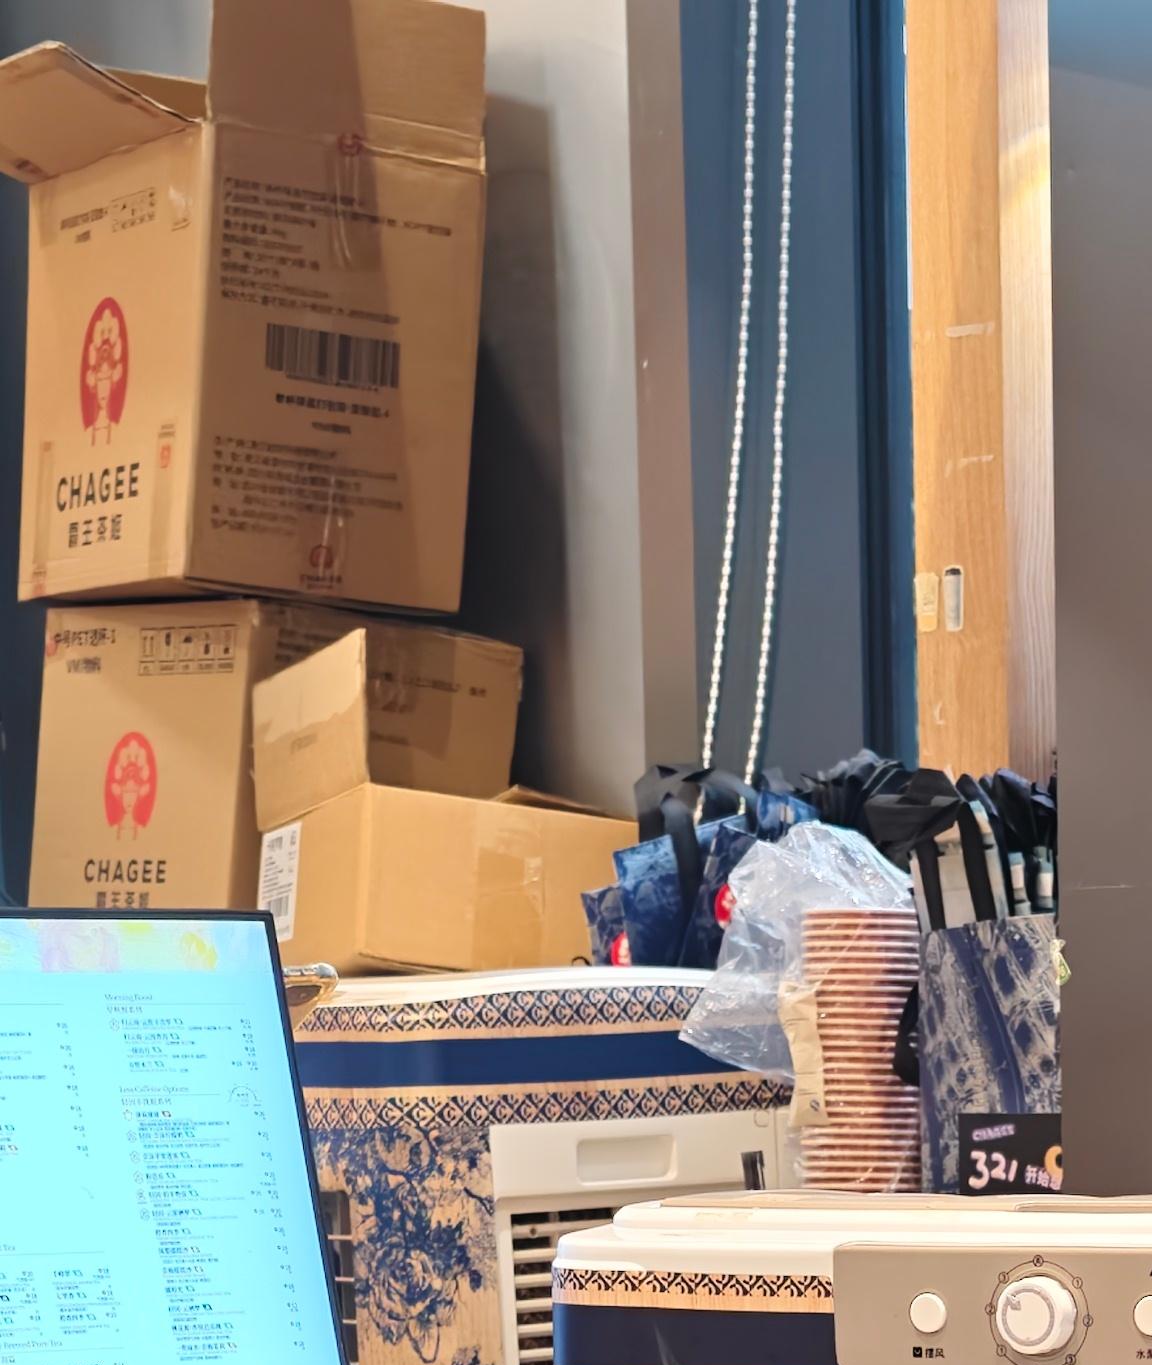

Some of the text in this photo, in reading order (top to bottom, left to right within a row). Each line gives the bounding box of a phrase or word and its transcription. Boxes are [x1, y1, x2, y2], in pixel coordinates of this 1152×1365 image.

[56, 462, 140, 512] CHAGEE
[84, 859, 167, 883] CHAGEE
[968, 1150, 1018, 1190] 321
